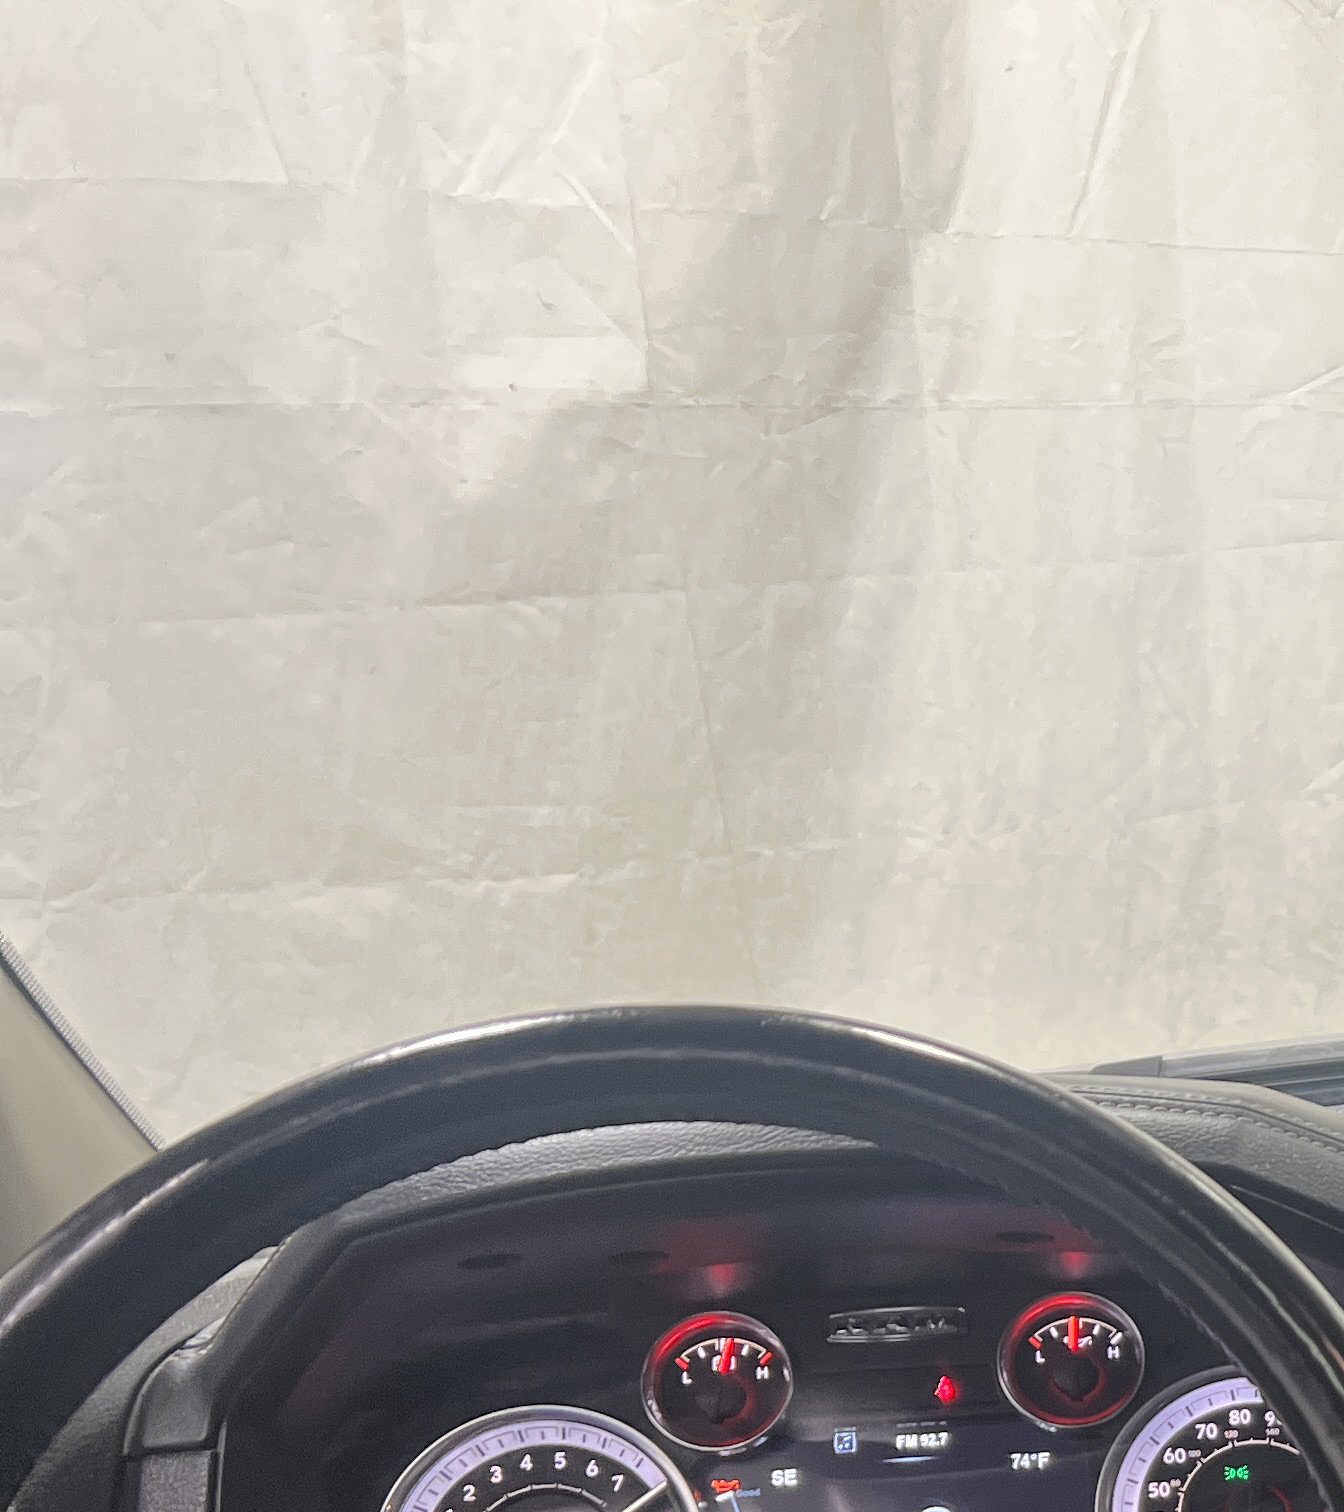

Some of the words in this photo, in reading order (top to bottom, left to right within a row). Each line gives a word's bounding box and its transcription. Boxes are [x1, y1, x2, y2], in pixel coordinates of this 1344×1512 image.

[1035, 1350, 1046, 1364] L
[1107, 1345, 1121, 1360] H
[681, 1371, 693, 1385] L
[755, 1365, 770, 1380] H
[1228, 1408, 1251, 1426] 80
[1264, 1410, 1281, 1427] 9
[895, 1433, 918, 1450] FM
[920, 1431, 949, 1447] 92.7
[1195, 1423, 1218, 1440] 70
[519, 1453, 533, 1472] 4
[554, 1451, 567, 1470] 5
[1010, 1451, 1050, 1469] 74°F
[1163, 1447, 1186, 1464] 60
[489, 1465, 503, 1484] 3
[585, 1459, 599, 1478] 6
[771, 1468, 798, 1487] SE
[611, 1473, 625, 1493] 7
[1148, 1481, 1170, 1498] 50
[463, 1484, 477, 1502] 2
